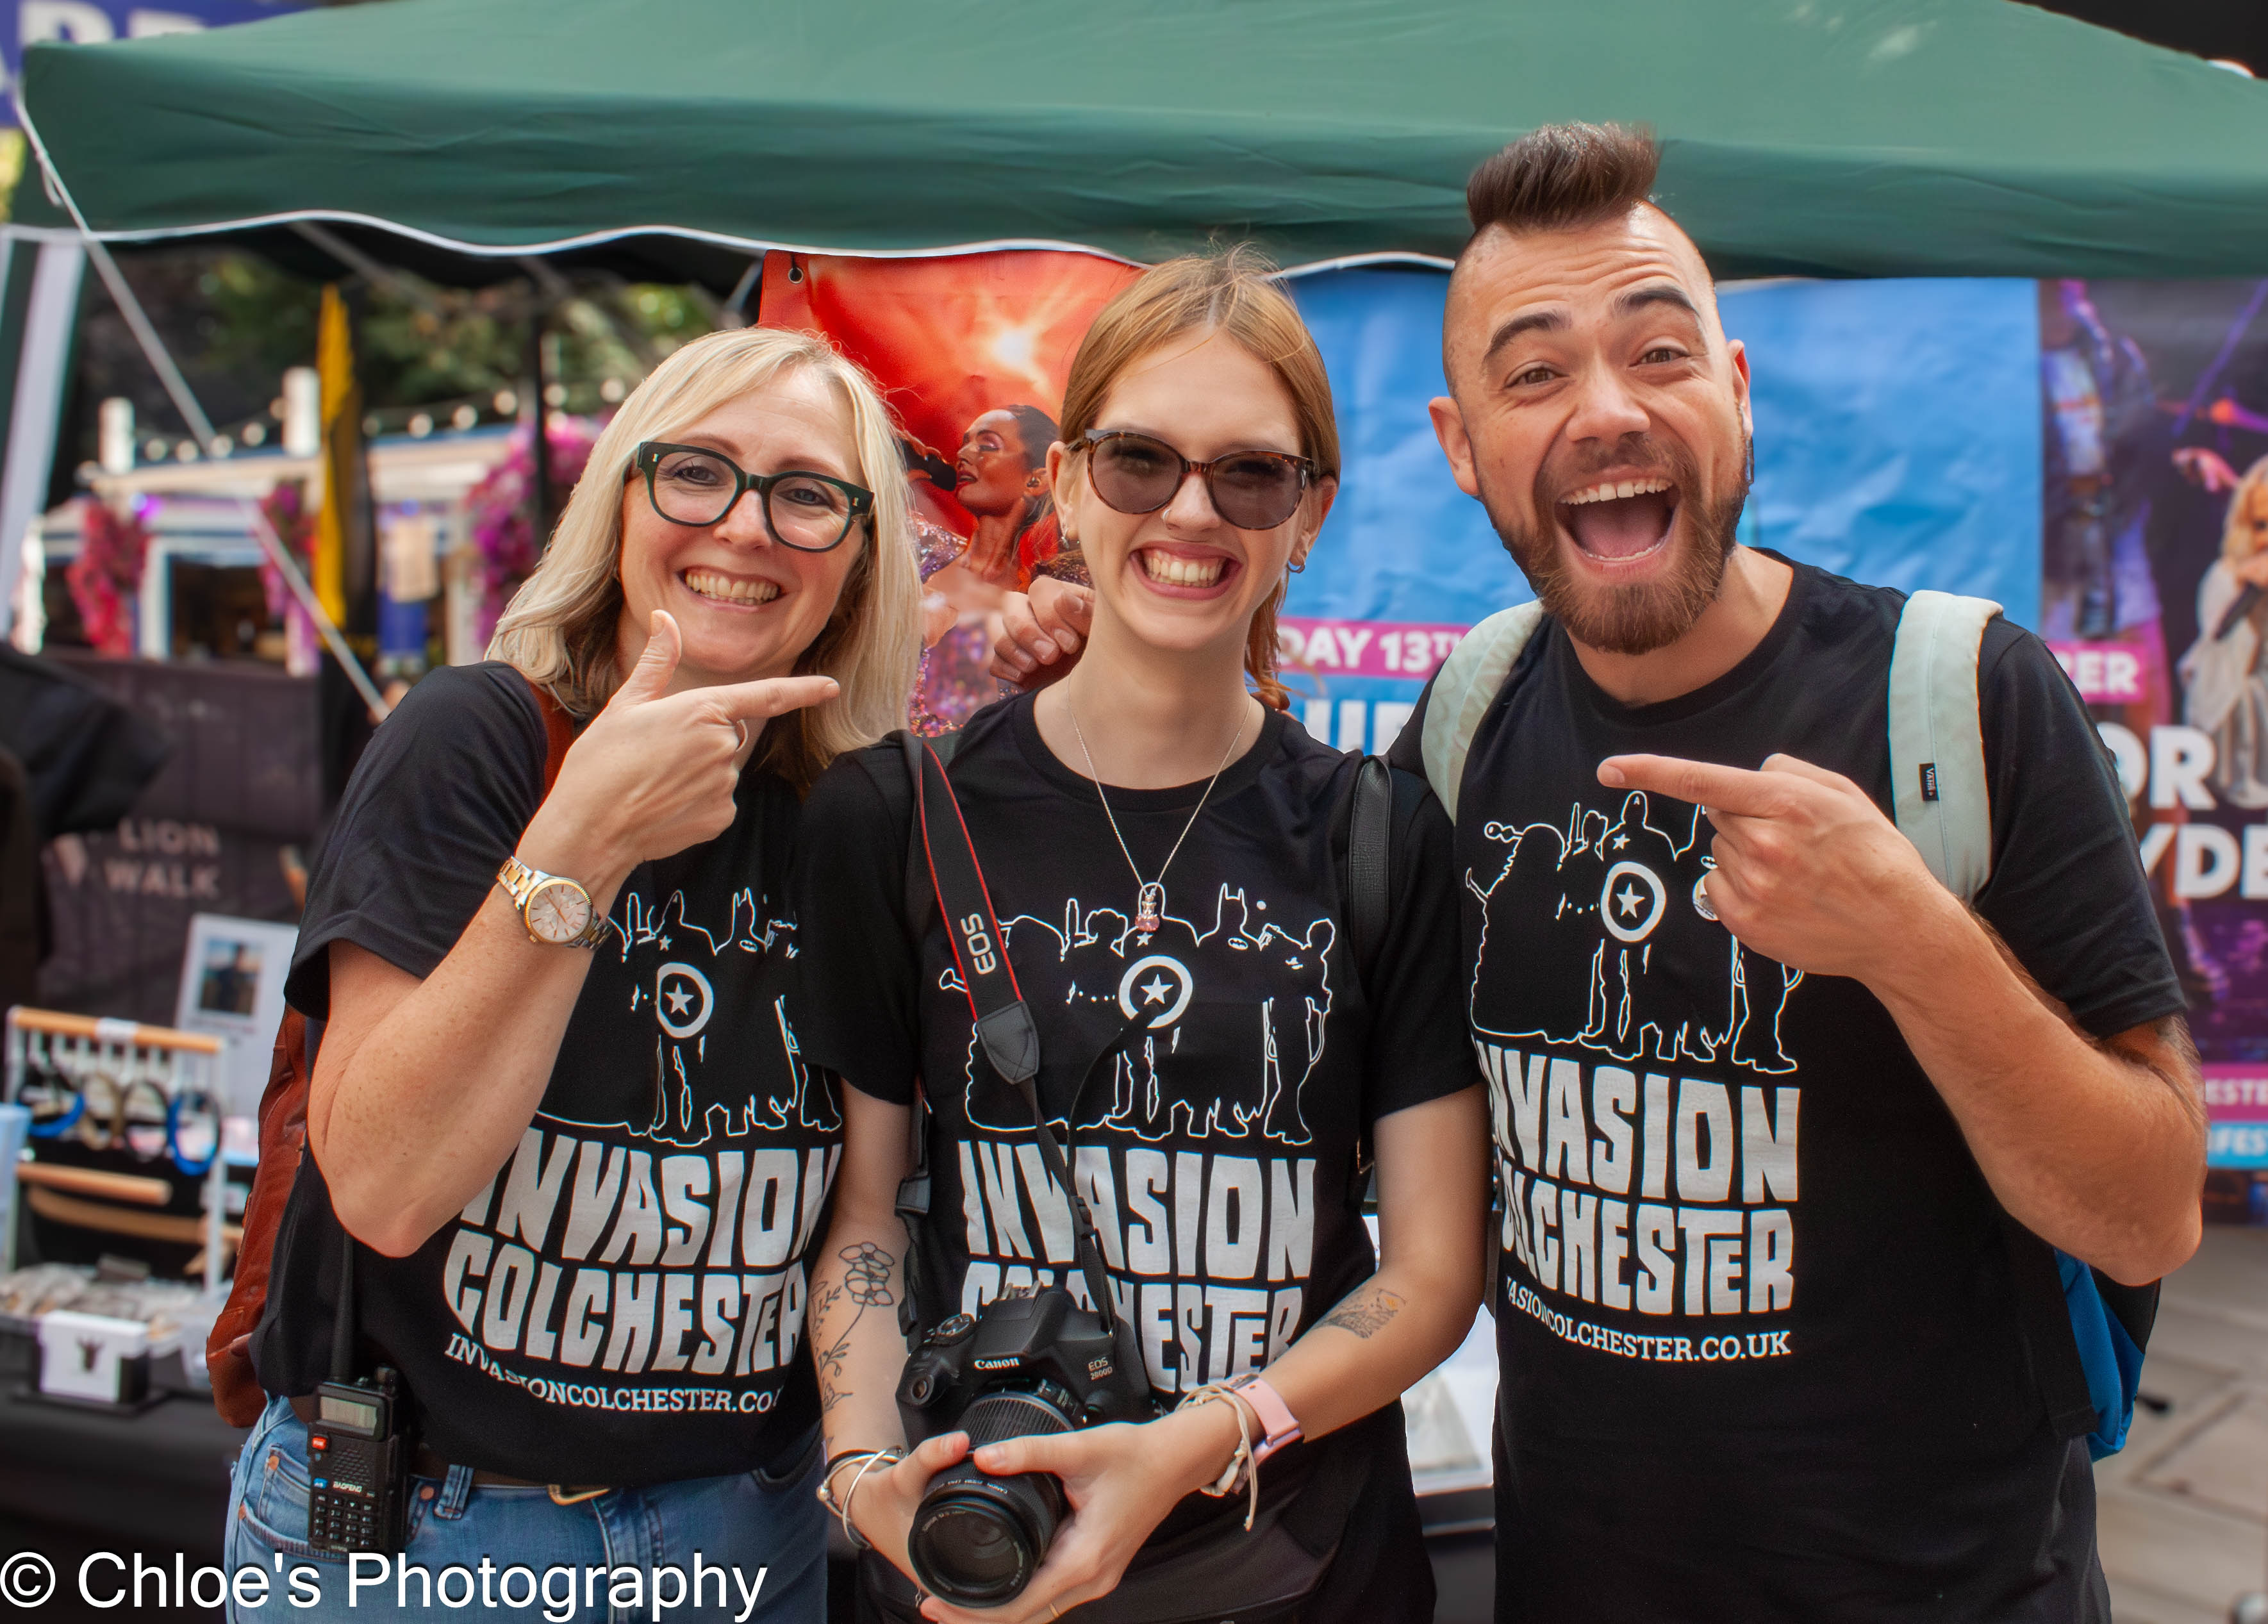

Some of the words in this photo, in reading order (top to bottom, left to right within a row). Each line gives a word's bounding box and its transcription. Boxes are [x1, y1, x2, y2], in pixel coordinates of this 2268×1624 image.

[118, 817, 220, 858] LION
[104, 859, 220, 898] WALK
[960, 913, 997, 975] EOS
[1475, 1038, 1800, 1204] NVASION
[958, 1139, 1316, 1282] INVASION
[1500, 1159, 1794, 1316] OLCHESTER
[444, 1332, 784, 1413] INVASIONCOLCHESTER.CO
[974, 1355, 1020, 1371] Canon
[1088, 1356, 1108, 1372] EOS
